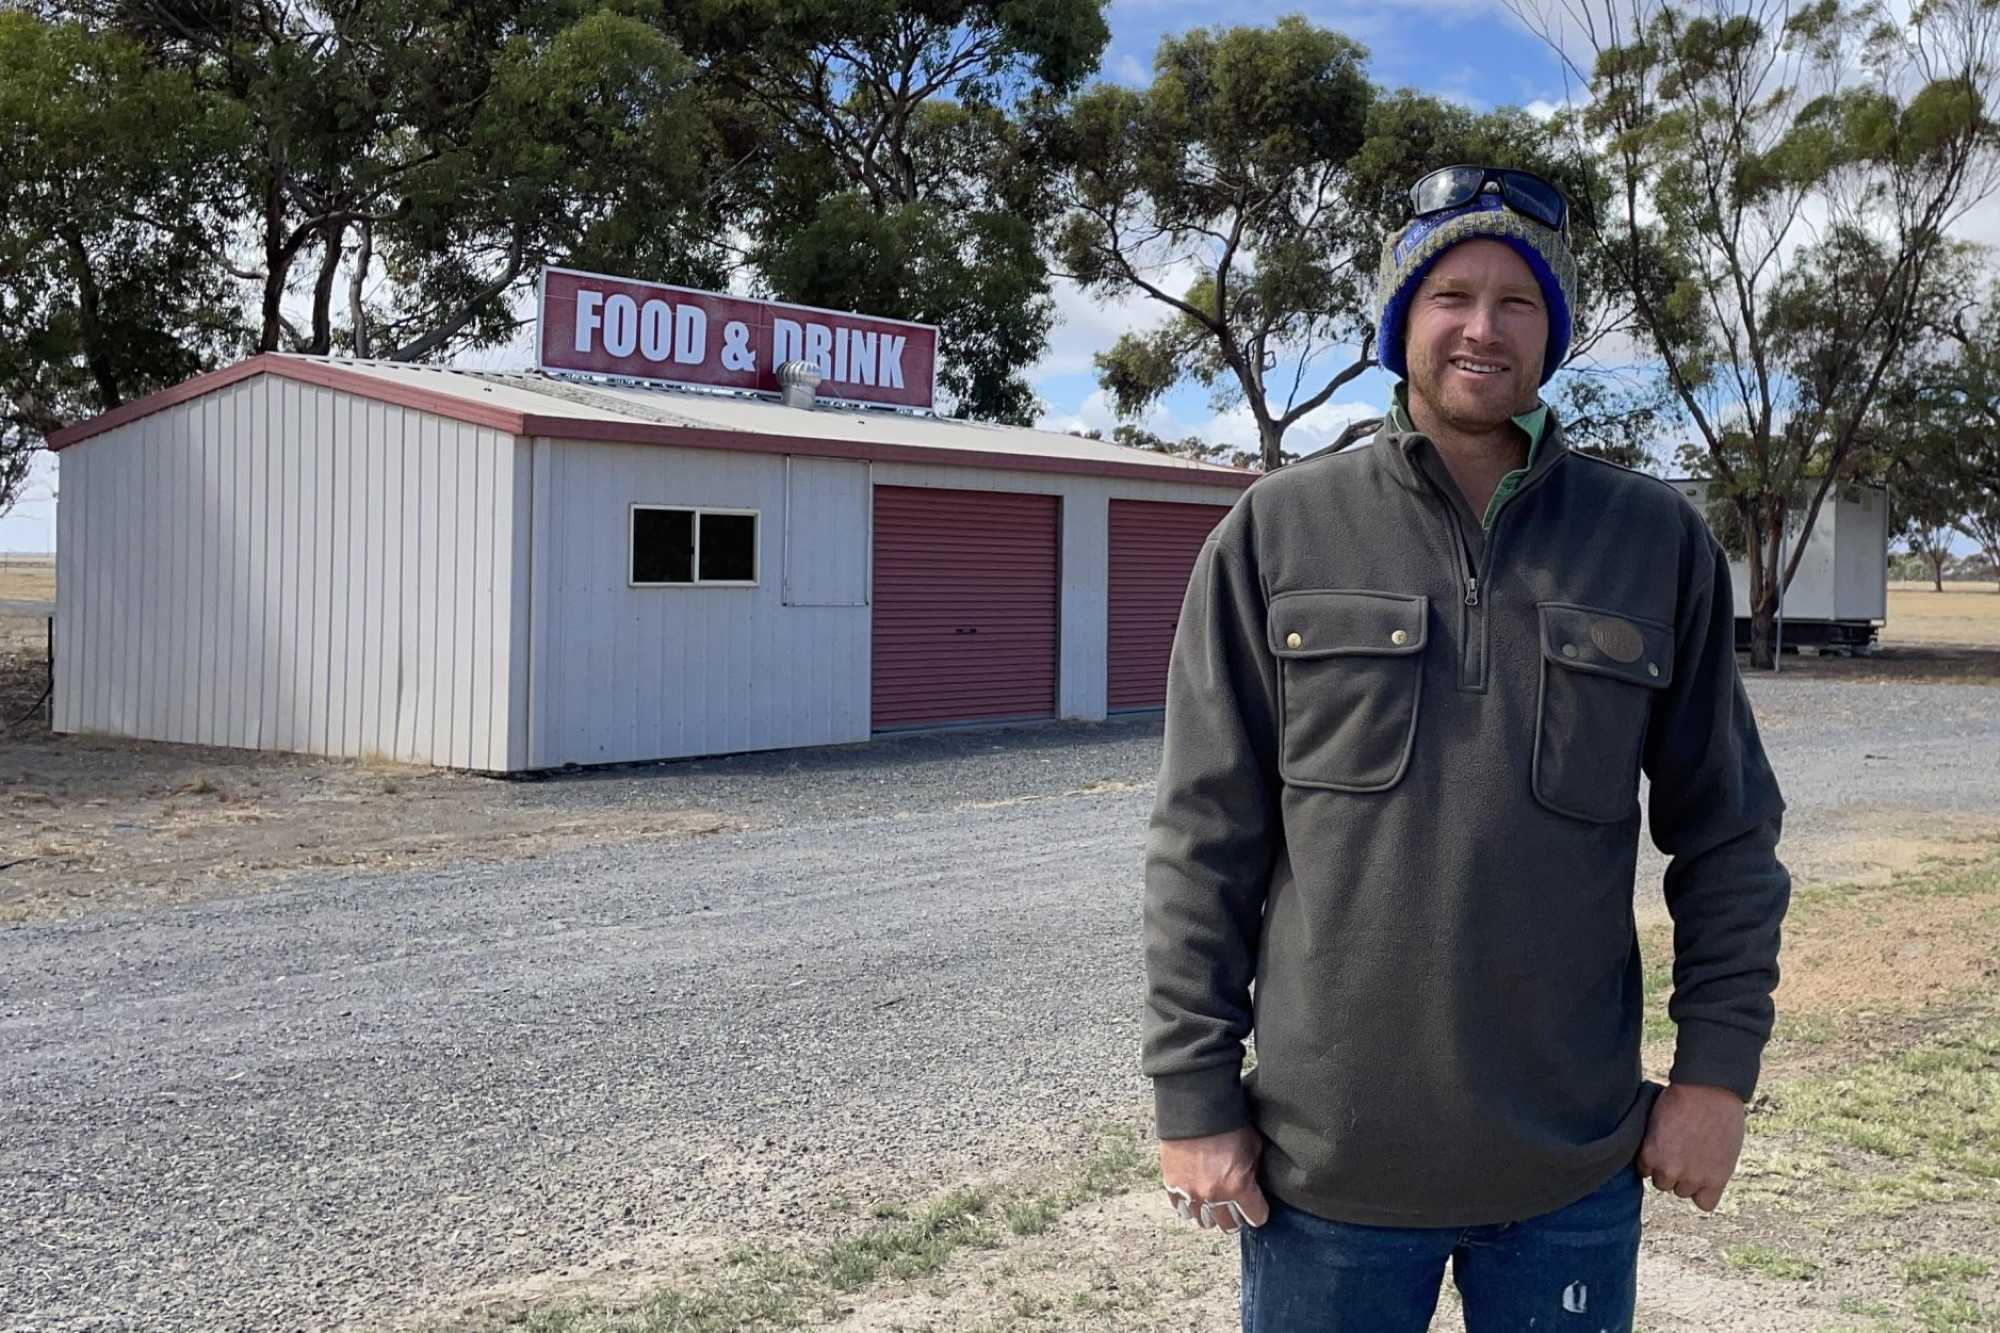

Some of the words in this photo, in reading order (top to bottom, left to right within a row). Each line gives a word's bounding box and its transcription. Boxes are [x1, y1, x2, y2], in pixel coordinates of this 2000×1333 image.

[575, 289, 707, 364] FOOD
[720, 321, 756, 372] &
[773, 318, 906, 389] DRINK
